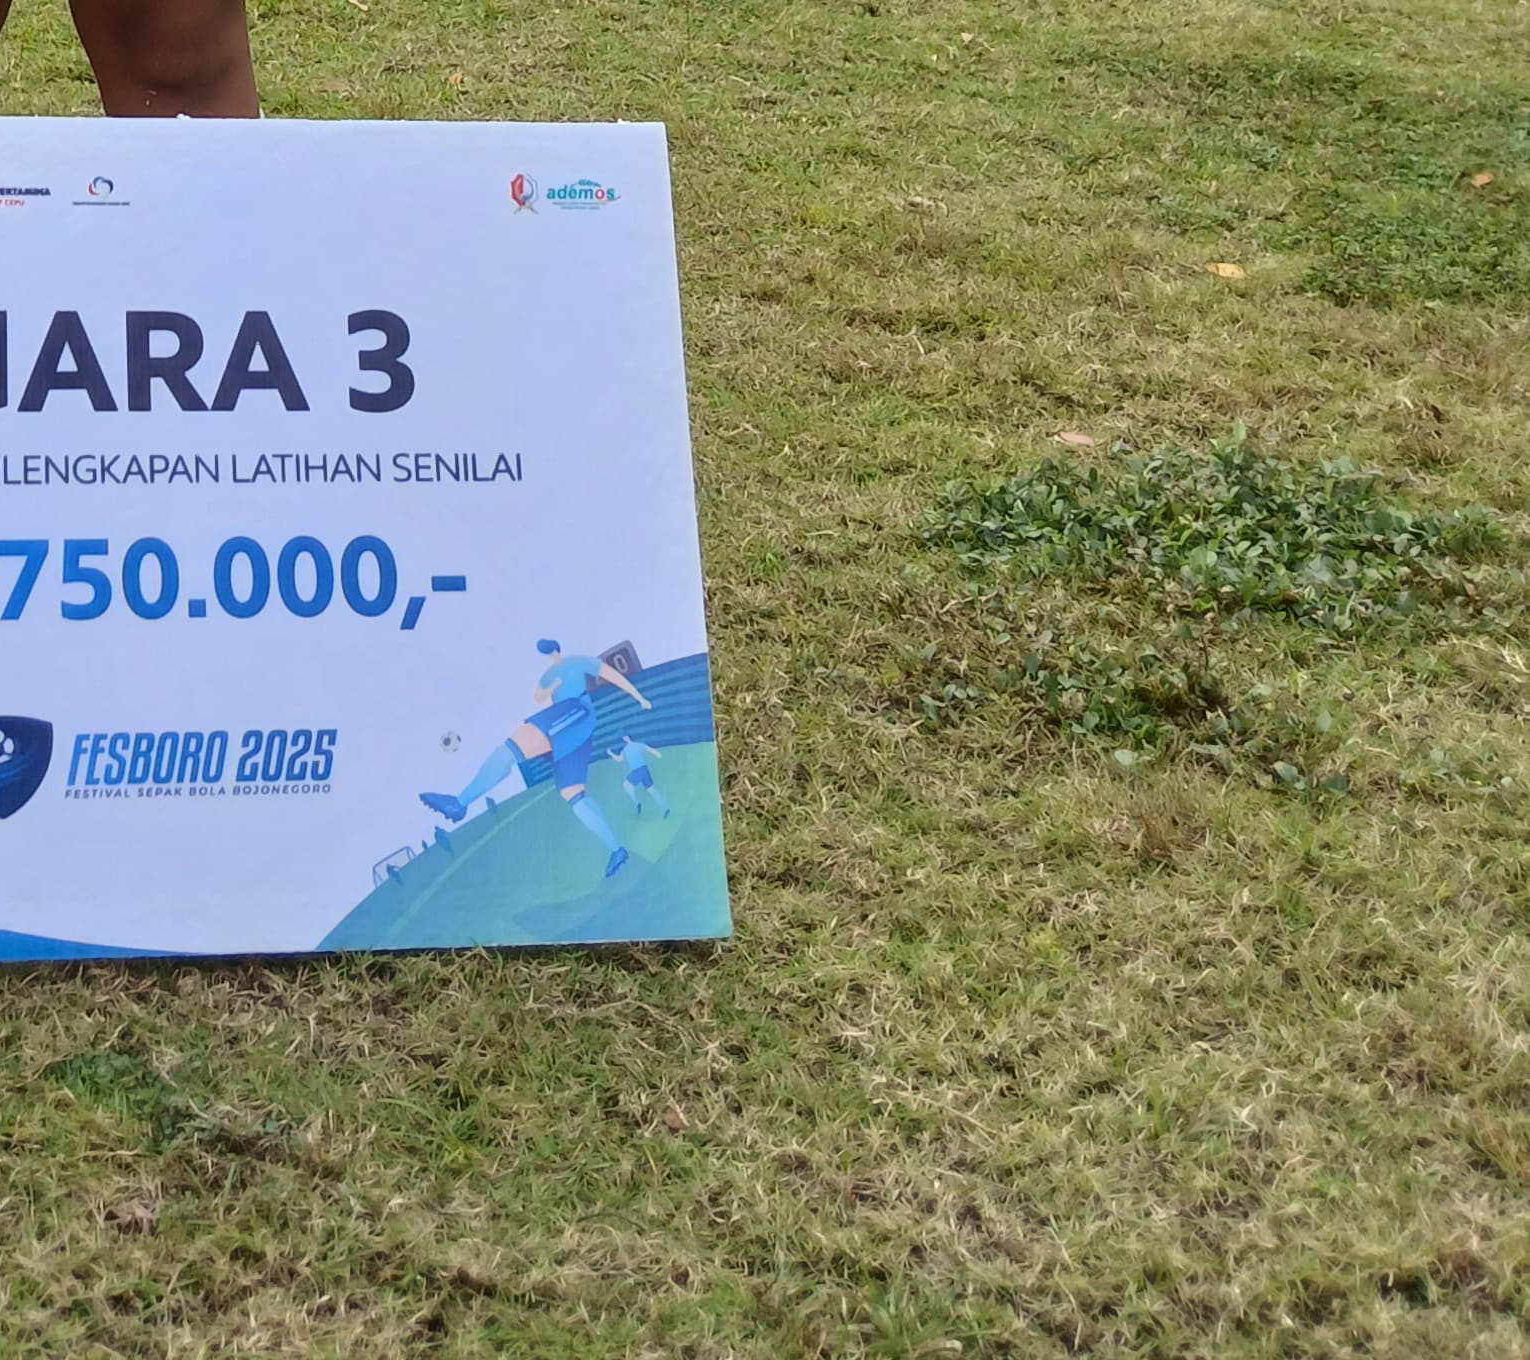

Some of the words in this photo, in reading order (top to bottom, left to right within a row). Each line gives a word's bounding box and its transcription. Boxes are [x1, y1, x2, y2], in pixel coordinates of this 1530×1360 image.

[546, 184, 615, 200] ademos
[346, 309, 417, 413] 3
[232, 453, 382, 484] LATIHAN
[392, 452, 523, 482] SENILAI
[66, 730, 229, 786] FESBORO
[235, 728, 338, 783] 2025
[64, 786, 131, 799] FESTIVAL
[137, 786, 183, 798] SEPAK
[189, 785, 227, 797] BOLA
[232, 783, 332, 796] BOJONEGORO
